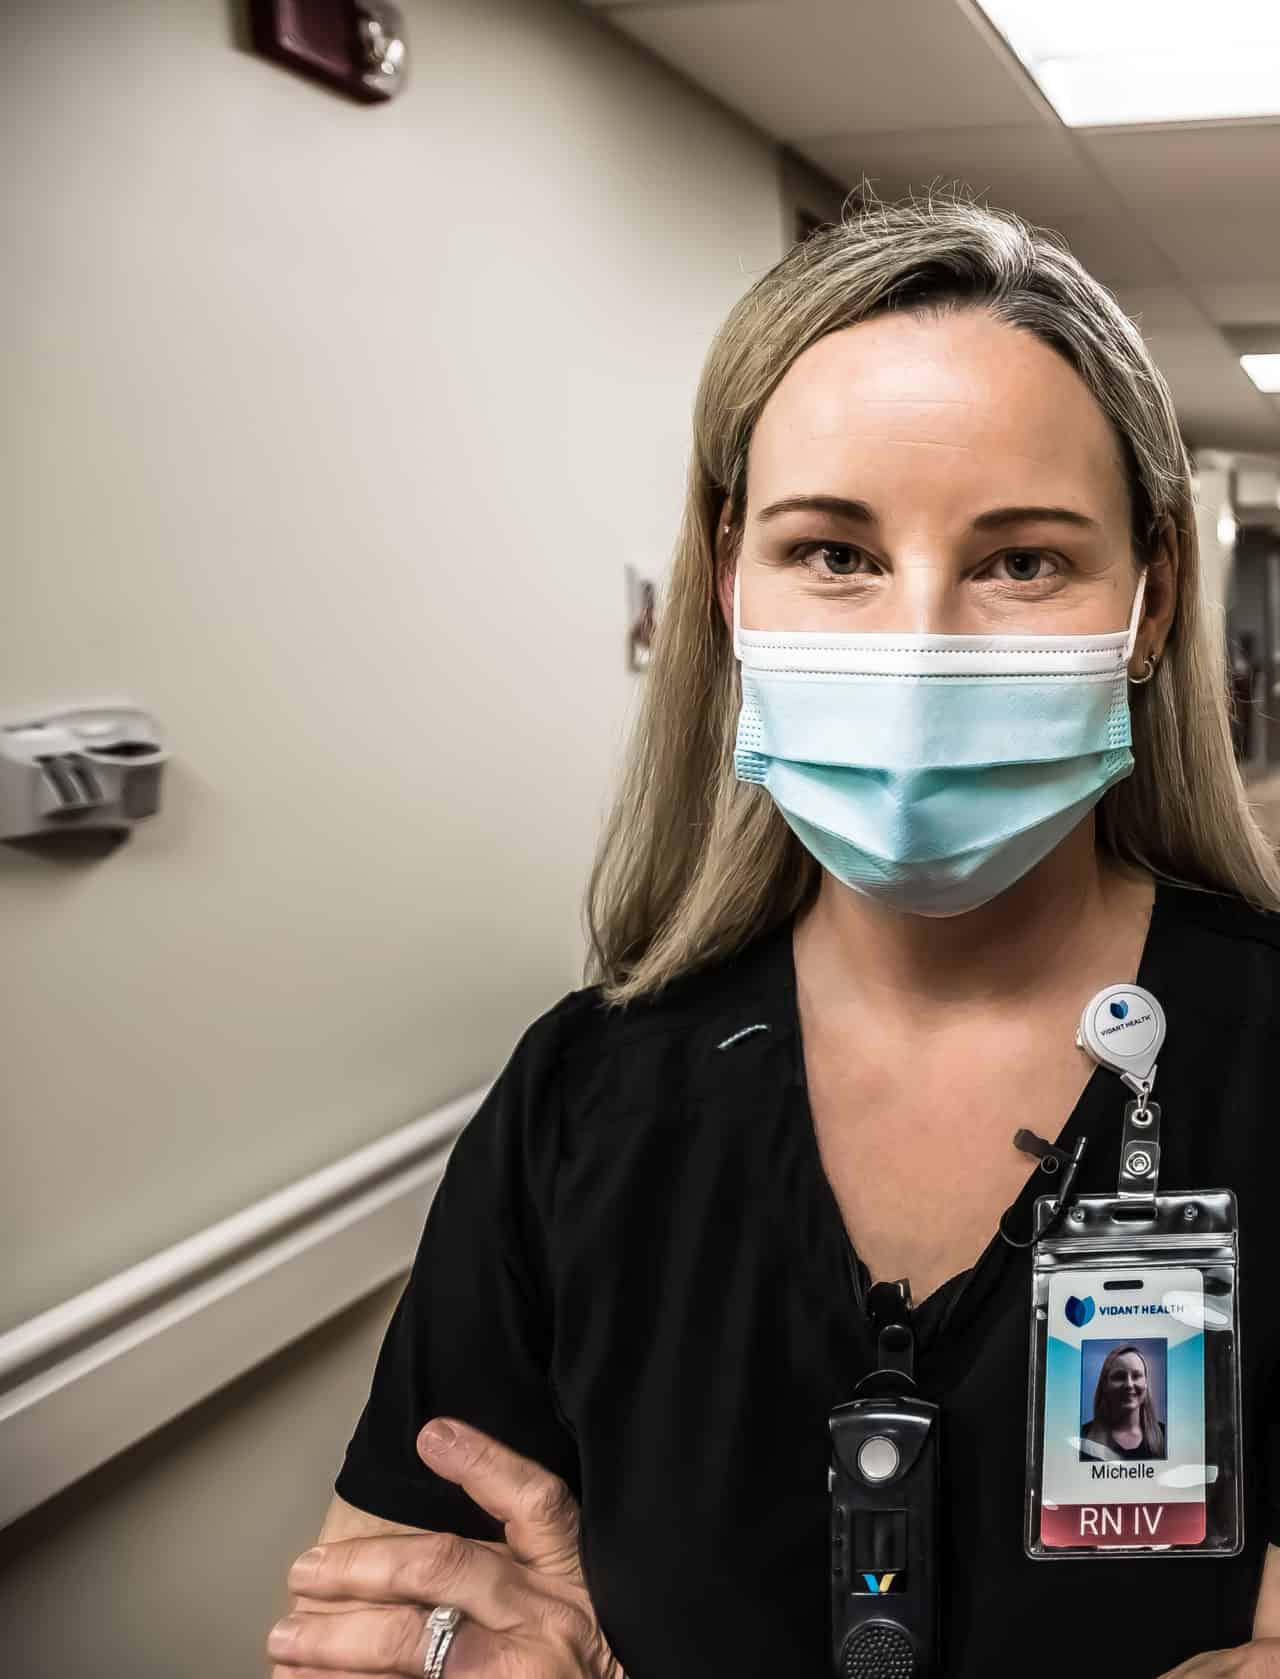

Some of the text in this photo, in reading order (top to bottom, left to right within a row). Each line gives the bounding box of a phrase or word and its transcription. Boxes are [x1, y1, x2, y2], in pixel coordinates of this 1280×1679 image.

[1101, 1015, 1151, 1036] VIDANT HEALTH
[1100, 1303, 1184, 1316] VIDANT HEALTH
[1091, 1463, 1155, 1480] Michelle
[1080, 1506, 1163, 1536] RN IV
